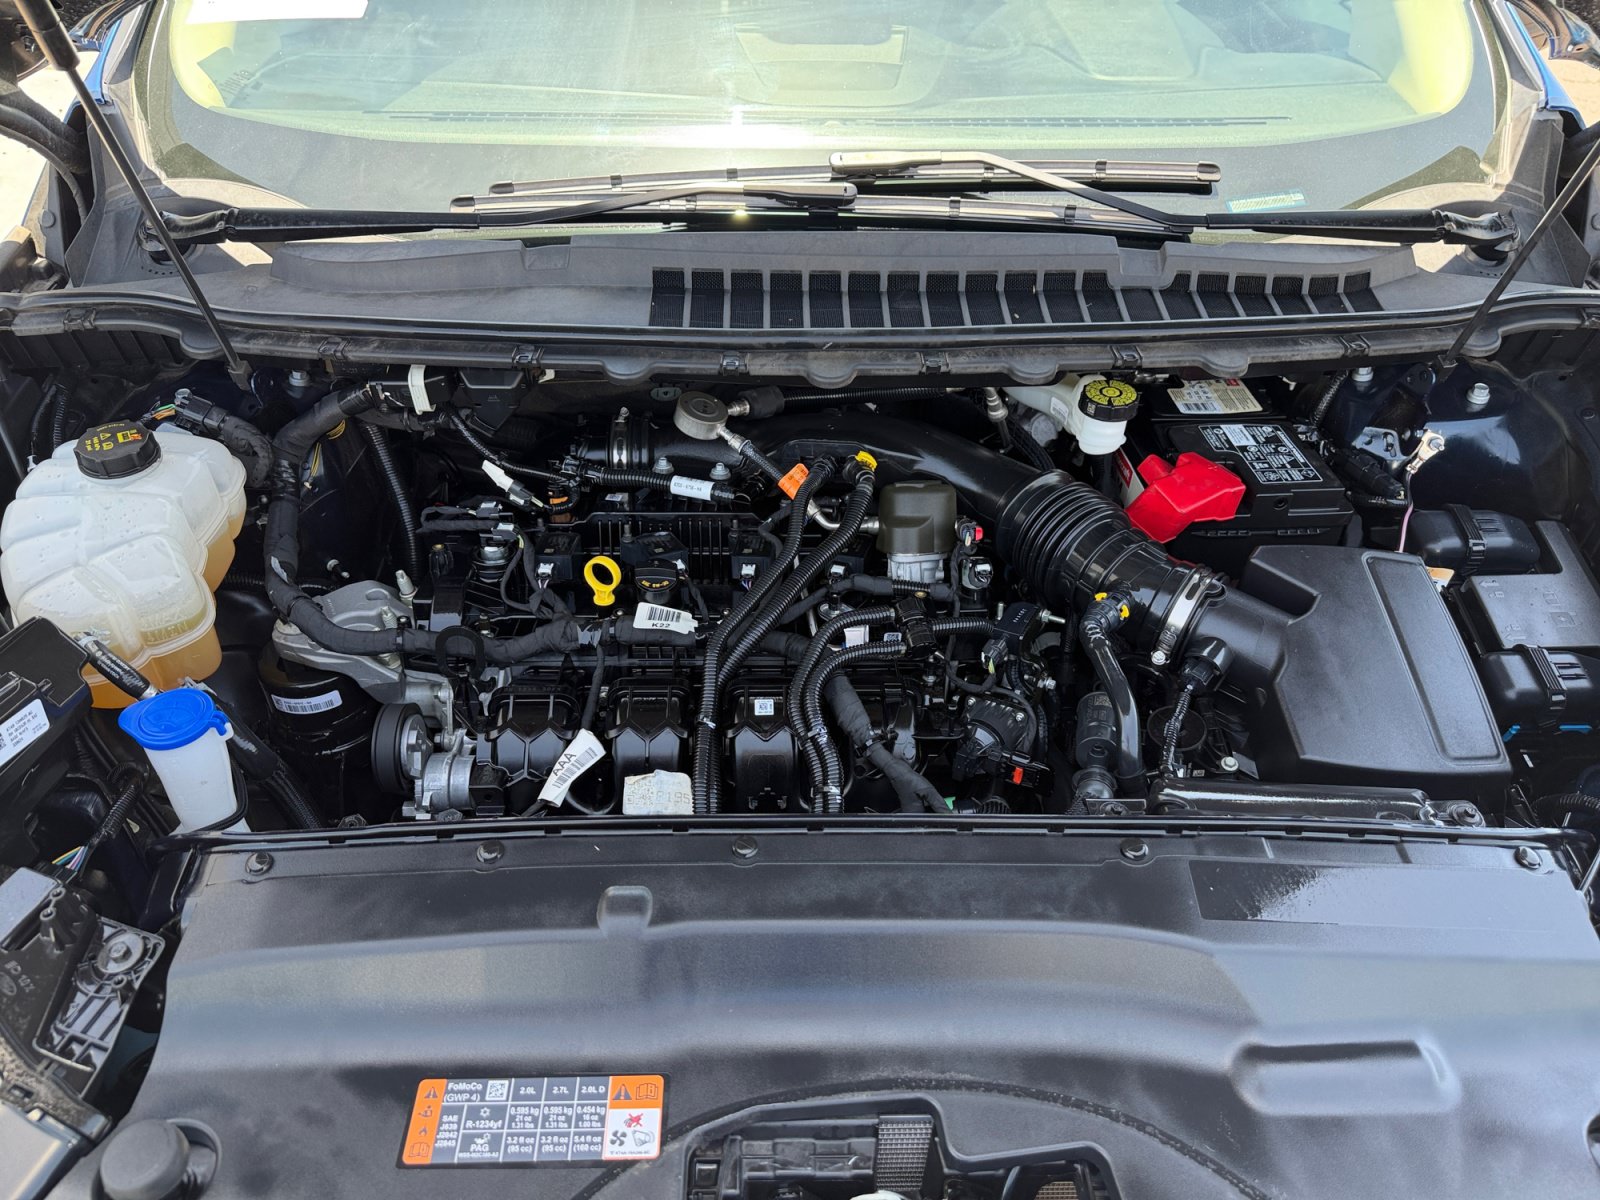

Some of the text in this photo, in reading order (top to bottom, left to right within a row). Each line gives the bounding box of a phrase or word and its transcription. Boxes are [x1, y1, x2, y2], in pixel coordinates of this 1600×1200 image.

[553, 752, 577, 776] AAA
[448, 1083, 482, 1091] FoMoCo
[519, 1086, 536, 1094] 2.0L
[552, 1086, 569, 1094] 2.7L
[444, 1093, 469, 1102] (GWP
[530, 1106, 539, 1116] kg
[564, 1106, 572, 1116] kg
[466, 1120, 502, 1129] R-1234yf
